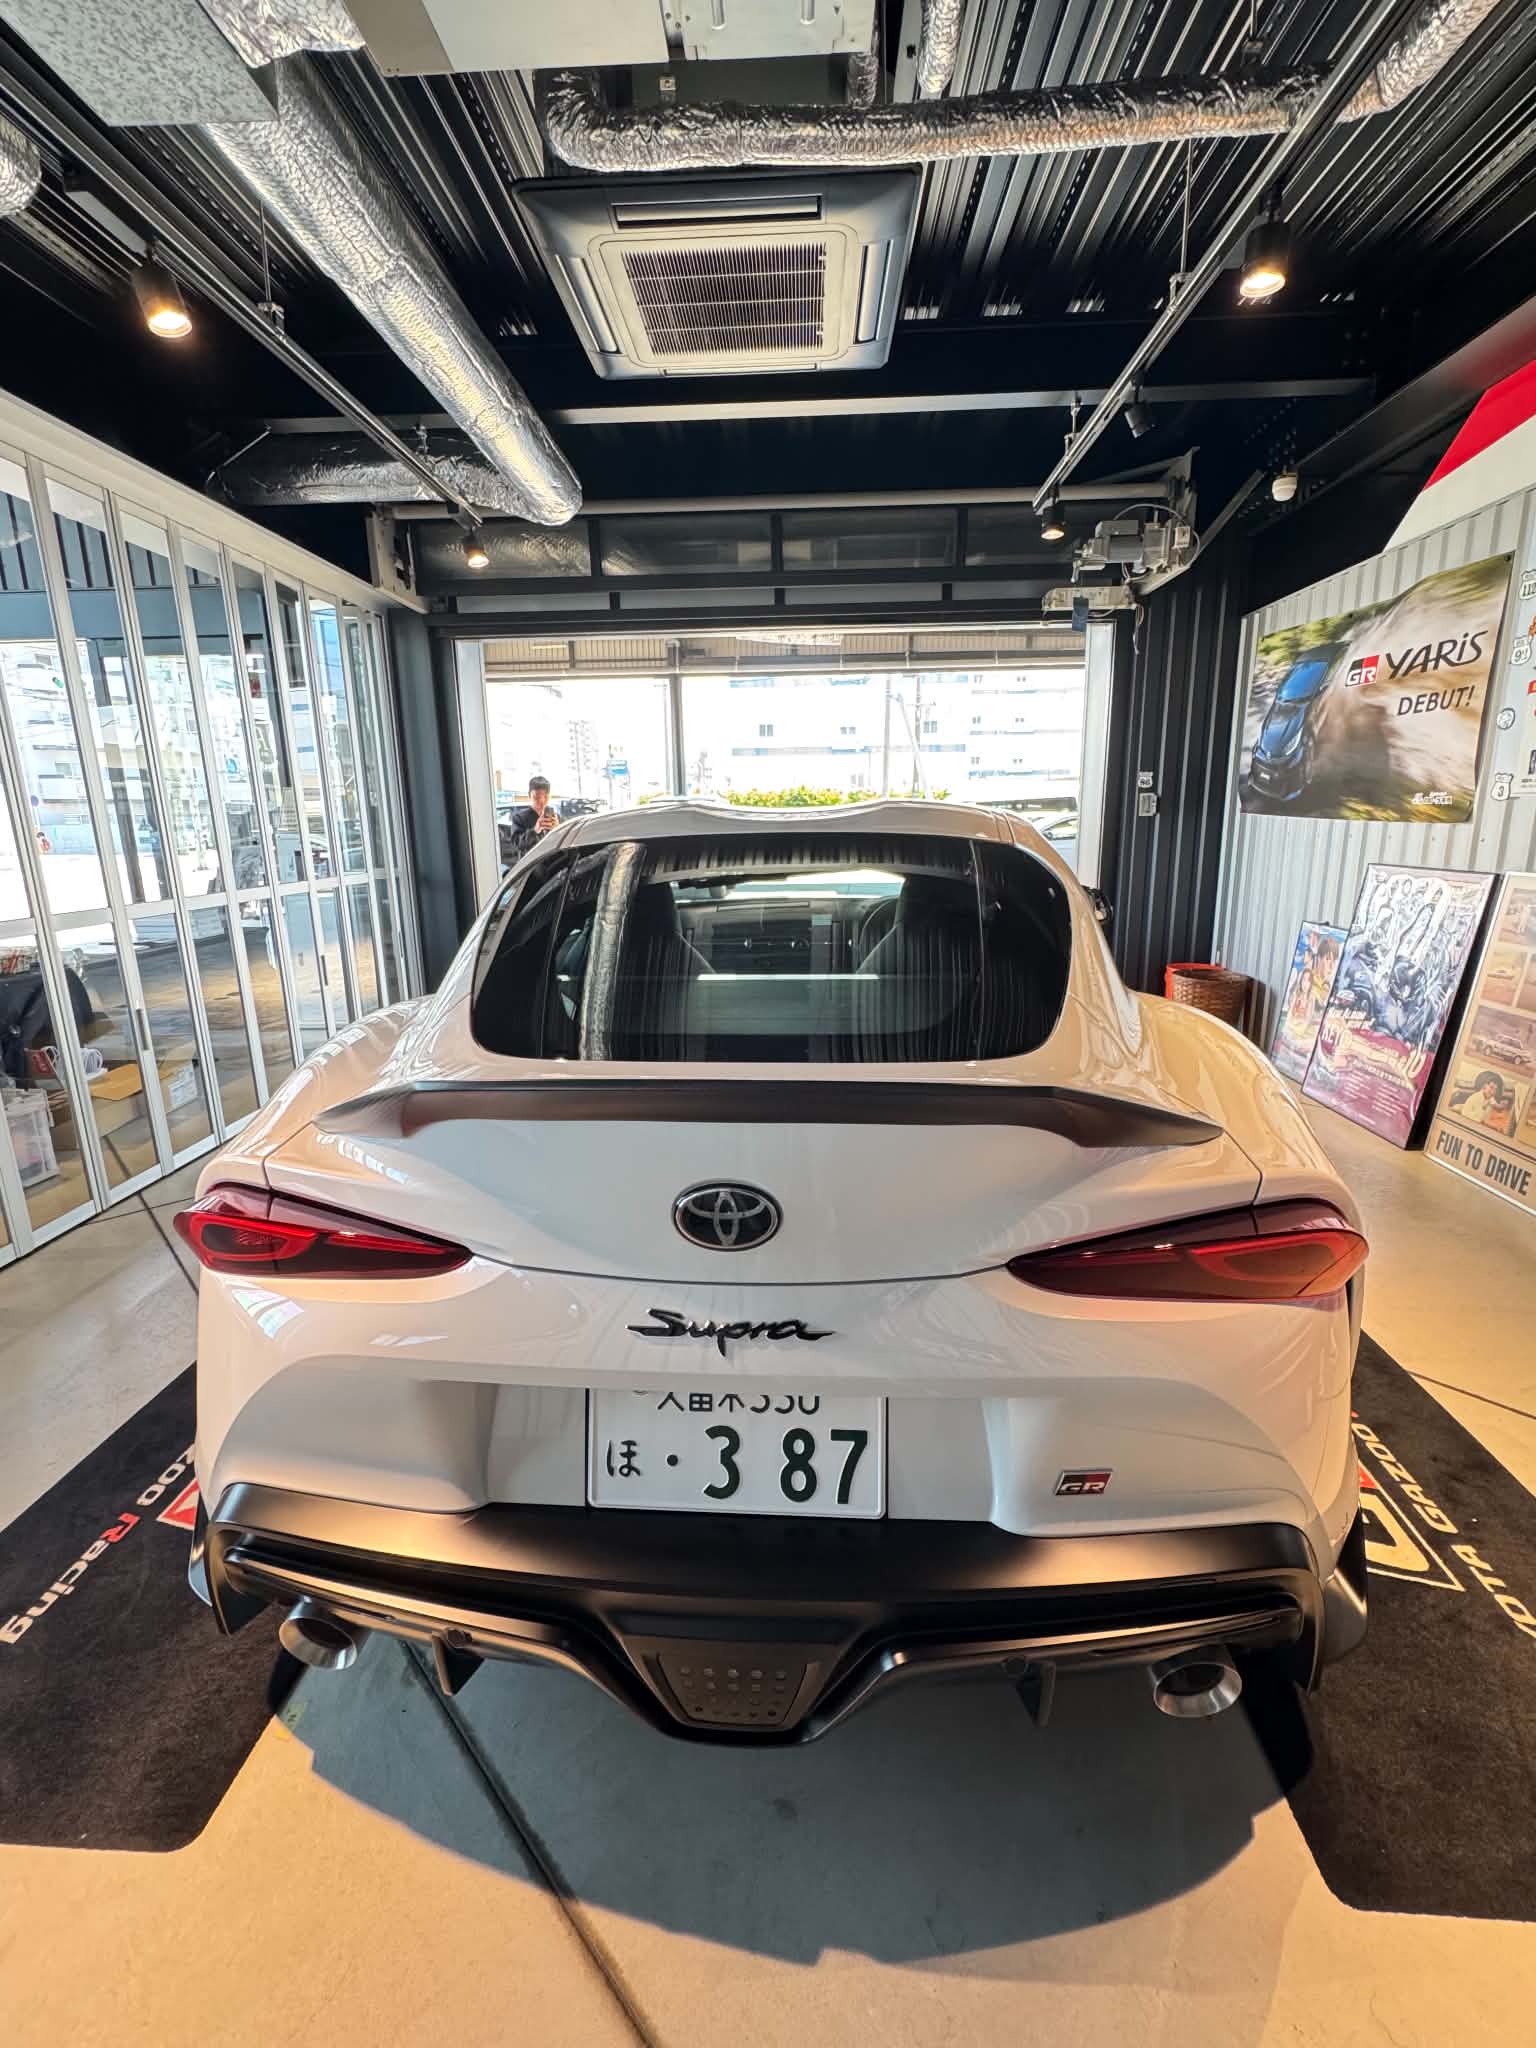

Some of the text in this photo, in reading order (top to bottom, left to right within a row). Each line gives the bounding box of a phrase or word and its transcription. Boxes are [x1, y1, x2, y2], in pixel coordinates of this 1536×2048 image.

[1345, 665, 1378, 687] GR
[1397, 685, 1475, 716] DEBUT!
[1436, 1130, 1532, 1196] FUN TO DRIVE
[625, 1308, 837, 1357] Supra
[606, 1440, 642, 1478] ほ
